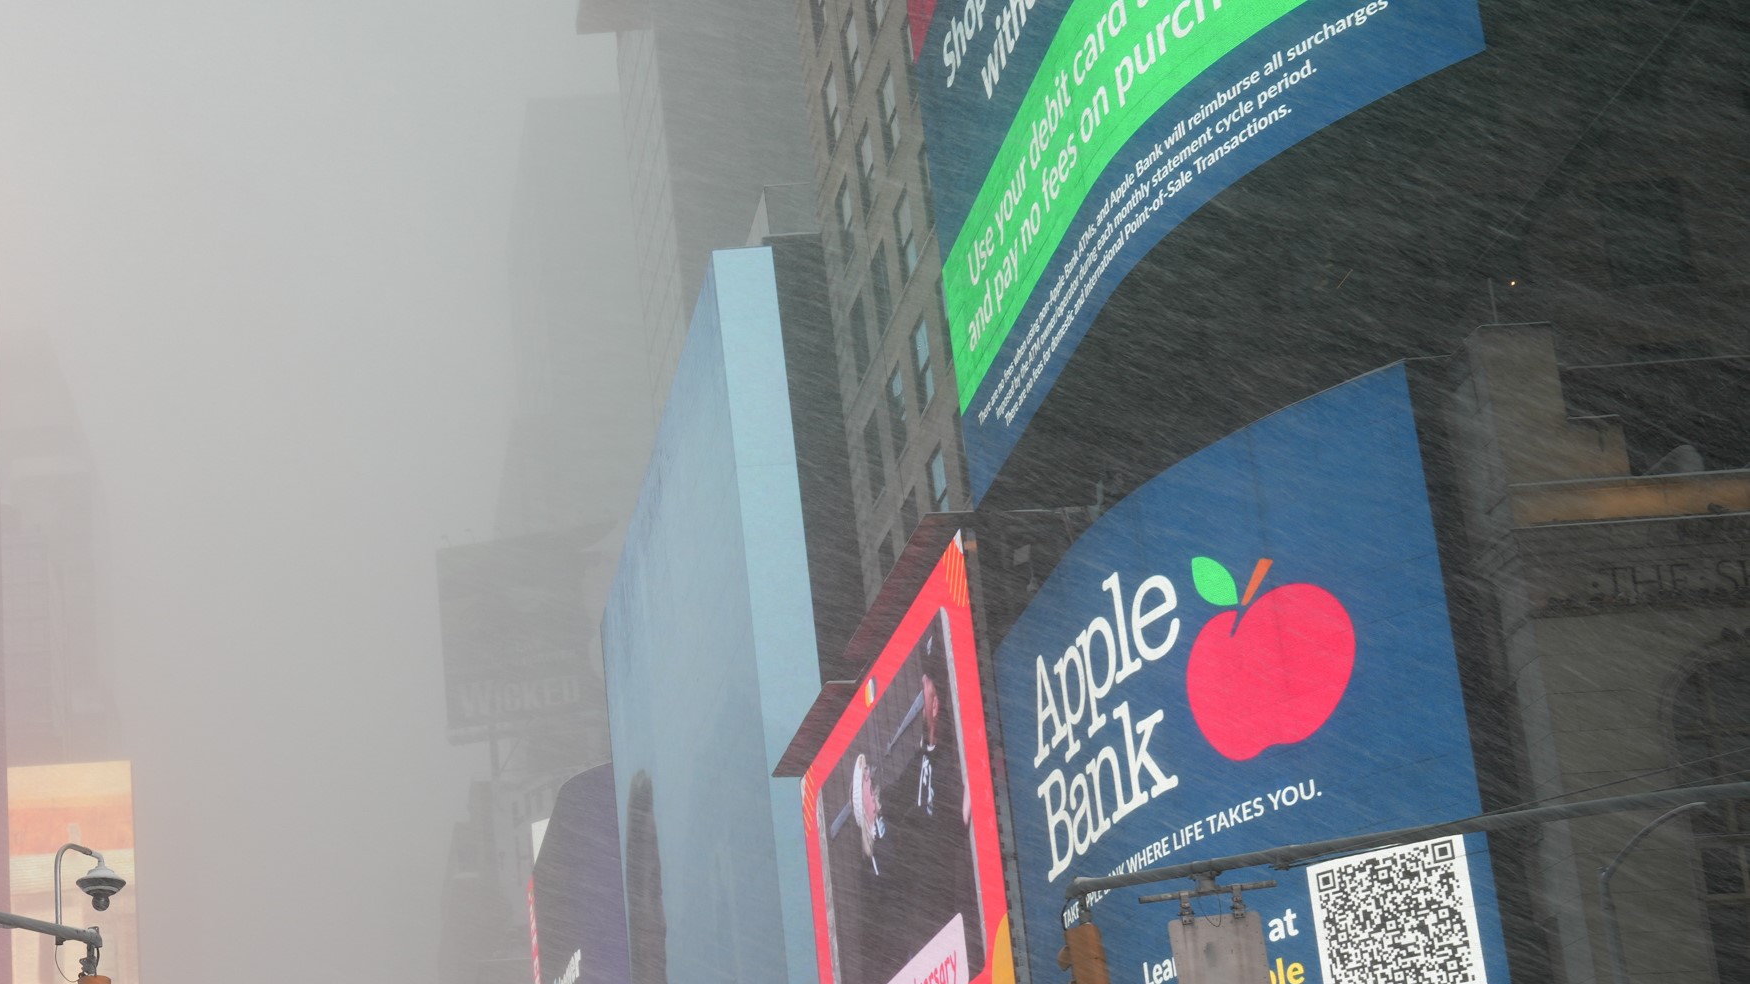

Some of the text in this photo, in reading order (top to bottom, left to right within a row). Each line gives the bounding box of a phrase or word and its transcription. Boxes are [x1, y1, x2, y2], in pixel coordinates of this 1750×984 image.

[967, 226, 994, 286] Use
[994, 155, 1027, 245] your
[1029, 69, 1071, 170] debit
[968, 84, 1110, 352] and pay no fees on
[978, 401, 991, 426] There
[1064, 249, 1079, 279] Bank
[1096, 204, 1110, 227] and
[1110, 173, 1135, 208] Apple
[1135, 142, 1163, 178] Bank
[1163, 121, 1185, 151] will
[1188, 69, 1260, 131] reimburse
[1264, 52, 1283, 77] all
[1286, 0, 1389, 62] surcharges
[1004, 402, 1019, 427] There
[1051, 309, 1075, 352] domestic
[1074, 289, 1085, 315] and
[1084, 234, 1125, 299] international
[1124, 171, 1193, 240] Point-of-Sale
[1193, 103, 1292, 174] Transactions.
[1029, 338, 1041, 365] ATM
[1078, 248, 1098, 280] during
[1097, 224, 1113, 250] each
[1114, 183, 1150, 226] monthly
[1152, 130, 1213, 187] statement
[1215, 99, 1253, 136] cycle
[1257, 59, 1317, 109] period.
[1033, 571, 1182, 769] Apple
[1037, 700, 1180, 883] Bank
[1126, 779, 1323, 874] WHERE LIFE TAKES YOU.
[1268, 908, 1299, 942] at
